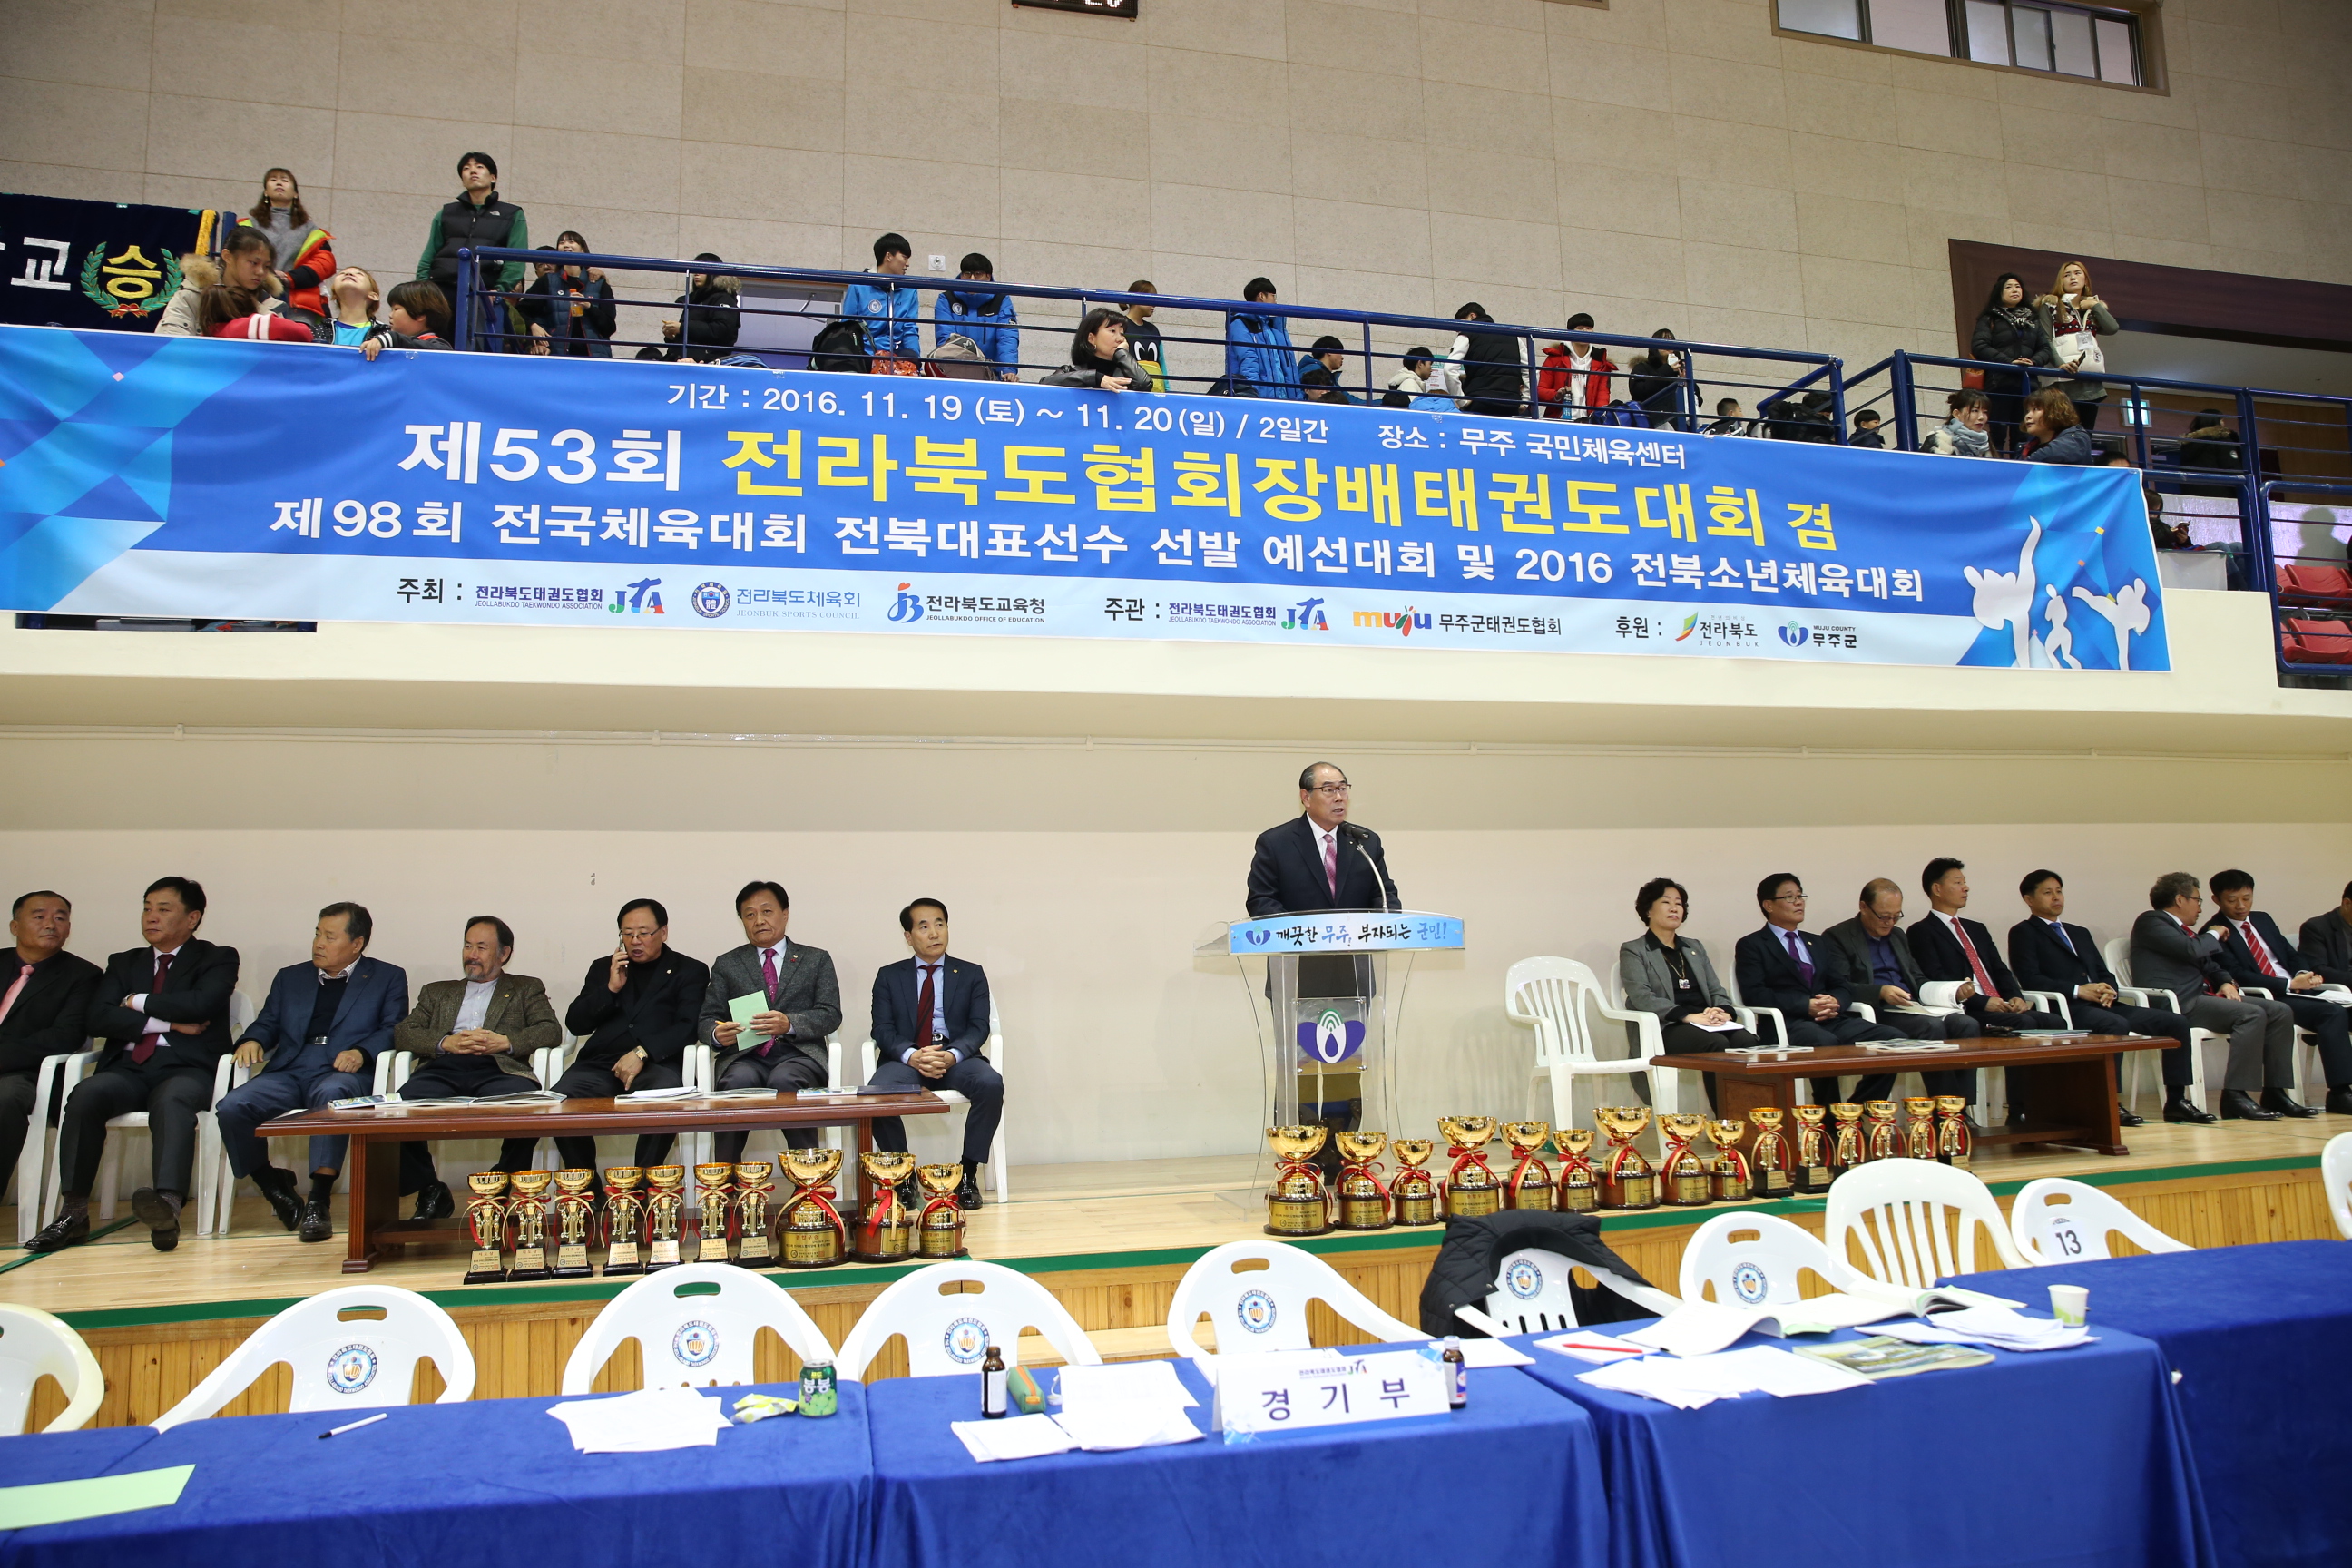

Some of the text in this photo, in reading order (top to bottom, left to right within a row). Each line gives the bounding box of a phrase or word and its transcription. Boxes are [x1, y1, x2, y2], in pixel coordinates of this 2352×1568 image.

[102, 244, 162, 299] 승
[667, 384, 729, 409] 기간
[763, 388, 846, 416] 2016.
[861, 392, 909, 419] 11.
[925, 394, 964, 421] 19
[975, 397, 1025, 426] (토)
[1076, 403, 1123, 431] 11.
[1259, 416, 1329, 444] 2일간
[1377, 424, 1430, 450] 장소
[1459, 427, 1516, 457] 무주
[1526, 431, 1688, 470] 국민체육센터
[399, 419, 1838, 551] 제53회 전라북도협회장배태권도대회 겸
[269, 497, 1924, 603] 제98회 전국체육대회 전북대표선수 선발 예선대회 및 2016 전북소년체육대회
[397, 576, 444, 606] 주최
[475, 584, 603, 603] 전라북도태권도협회
[609, 577, 665, 614] JTA
[737, 588, 860, 608] 전라북도체육회
[474, 600, 603, 611] JEOLLABUKDO TAEKWONDO ASSOCIATION
[736, 609, 860, 620] JEONBUK SPORTS COUNCIL
[926, 595, 1045, 614] 전라북도교육청
[1104, 597, 1145, 622] 주관
[1168, 602, 1277, 620] 전라북도태권도협회
[1280, 597, 1330, 631] JTA
[926, 614, 974, 622] JEOLLABUKDO
[1168, 616, 1277, 627] JEOLLABUKDO TAEKWONDO ASSOCIATION
[1438, 612, 1563, 636] 무주군태권도협회
[1615, 615, 1650, 640] 후원
[1700, 621, 1759, 640] 전라북도
[1812, 633, 1858, 649] 무주군
[1276, 926, 1318, 946] 깨끗한
[1358, 923, 1412, 943] 부자되는
[1416, 921, 1448, 941] 군민!
[2054, 1229, 2082, 1257] 13
[803, 1377, 831, 1394] 봉봉
